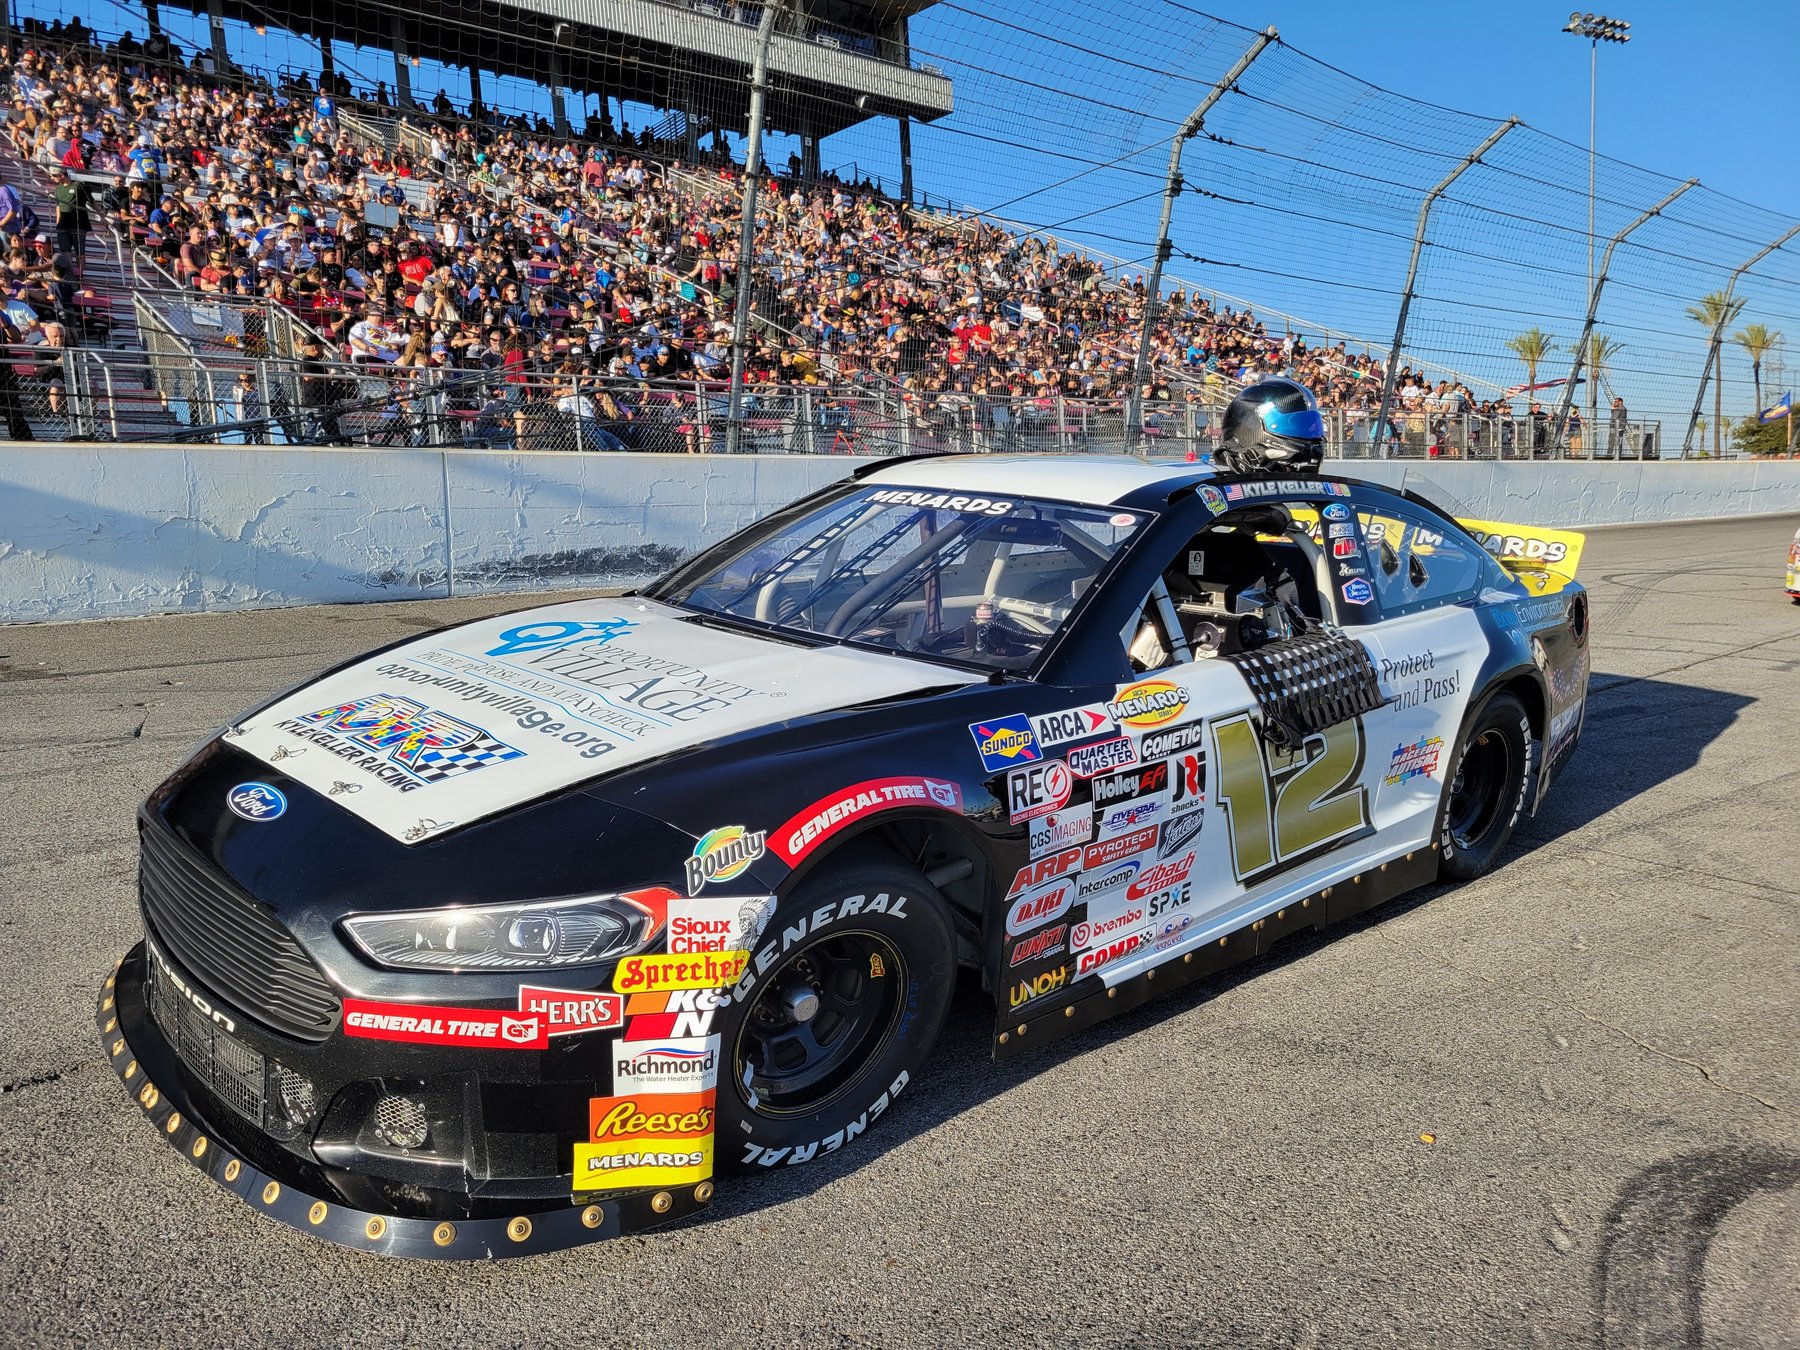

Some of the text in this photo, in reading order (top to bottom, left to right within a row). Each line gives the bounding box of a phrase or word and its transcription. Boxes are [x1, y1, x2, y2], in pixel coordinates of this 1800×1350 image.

[866, 489, 1014, 516] MENARDS
[1241, 480, 1326, 499] KYLE KELLER
[1329, 504, 1346, 517] Ford
[580, 643, 770, 701] OPPORTUNITY
[1380, 648, 1436, 683] Protect
[526, 647, 734, 722] VILLAGE
[1393, 669, 1461, 713] and Pass!
[515, 678, 556, 694] AND
[551, 689, 568, 699] A
[561, 692, 658, 738] PAYCHECK.
[1108, 687, 1190, 721] MENARDS
[1157, 709, 1173, 718] SERIES
[1040, 711, 1087, 744] ARCA
[1142, 725, 1201, 757] COMETIC
[273, 718, 316, 738] KYLE
[306, 729, 366, 764] KELLER
[354, 755, 425, 794] RACING
[984, 731, 1031, 754] SUNOCO
[1069, 739, 1129, 768] QUARTER
[1147, 750, 1171, 761] GASKET
[1081, 753, 1134, 776] MASTER
[233, 786, 277, 817] Ford
[1095, 774, 1141, 800] Holley
[1209, 708, 1378, 888] 12
[787, 792, 883, 856] GENERAL
[881, 784, 926, 801] TIRE
[1012, 803, 1059, 822] RACING ELECTRONICS
[1111, 803, 1156, 824] FIVE STAR
[1170, 799, 1200, 815] shocks
[1088, 829, 1154, 860] PYROTECT
[1101, 844, 1141, 863] SAFETY GEAR
[685, 830, 765, 896] Bounty
[1008, 848, 1082, 896] ARP
[1078, 868, 1134, 897] Intercomp
[671, 916, 731, 936] Sioux
[1093, 908, 1143, 938] brembo
[671, 935, 726, 954] Chief
[733, 892, 909, 1002] GENERAL
[1012, 924, 1067, 963] LUNATI
[1042, 944, 1067, 959] CRANKS
[1079, 934, 1140, 976] COMP
[620, 954, 745, 991] Sprecher
[1009, 966, 1066, 1007] UNOH
[528, 998, 612, 1025] HERR'S
[664, 990, 732, 1014] K&
[346, 1012, 447, 1035] GENERAL
[448, 1021, 500, 1038] TIRE
[669, 1011, 715, 1038] N
[617, 1050, 714, 1078] Richmond
[632, 1072, 714, 1084] The Water Heater Experts
[595, 1101, 714, 1139] Reese's
[740, 1069, 910, 1167] GENERAL
[588, 1150, 704, 1171] MENARDS
